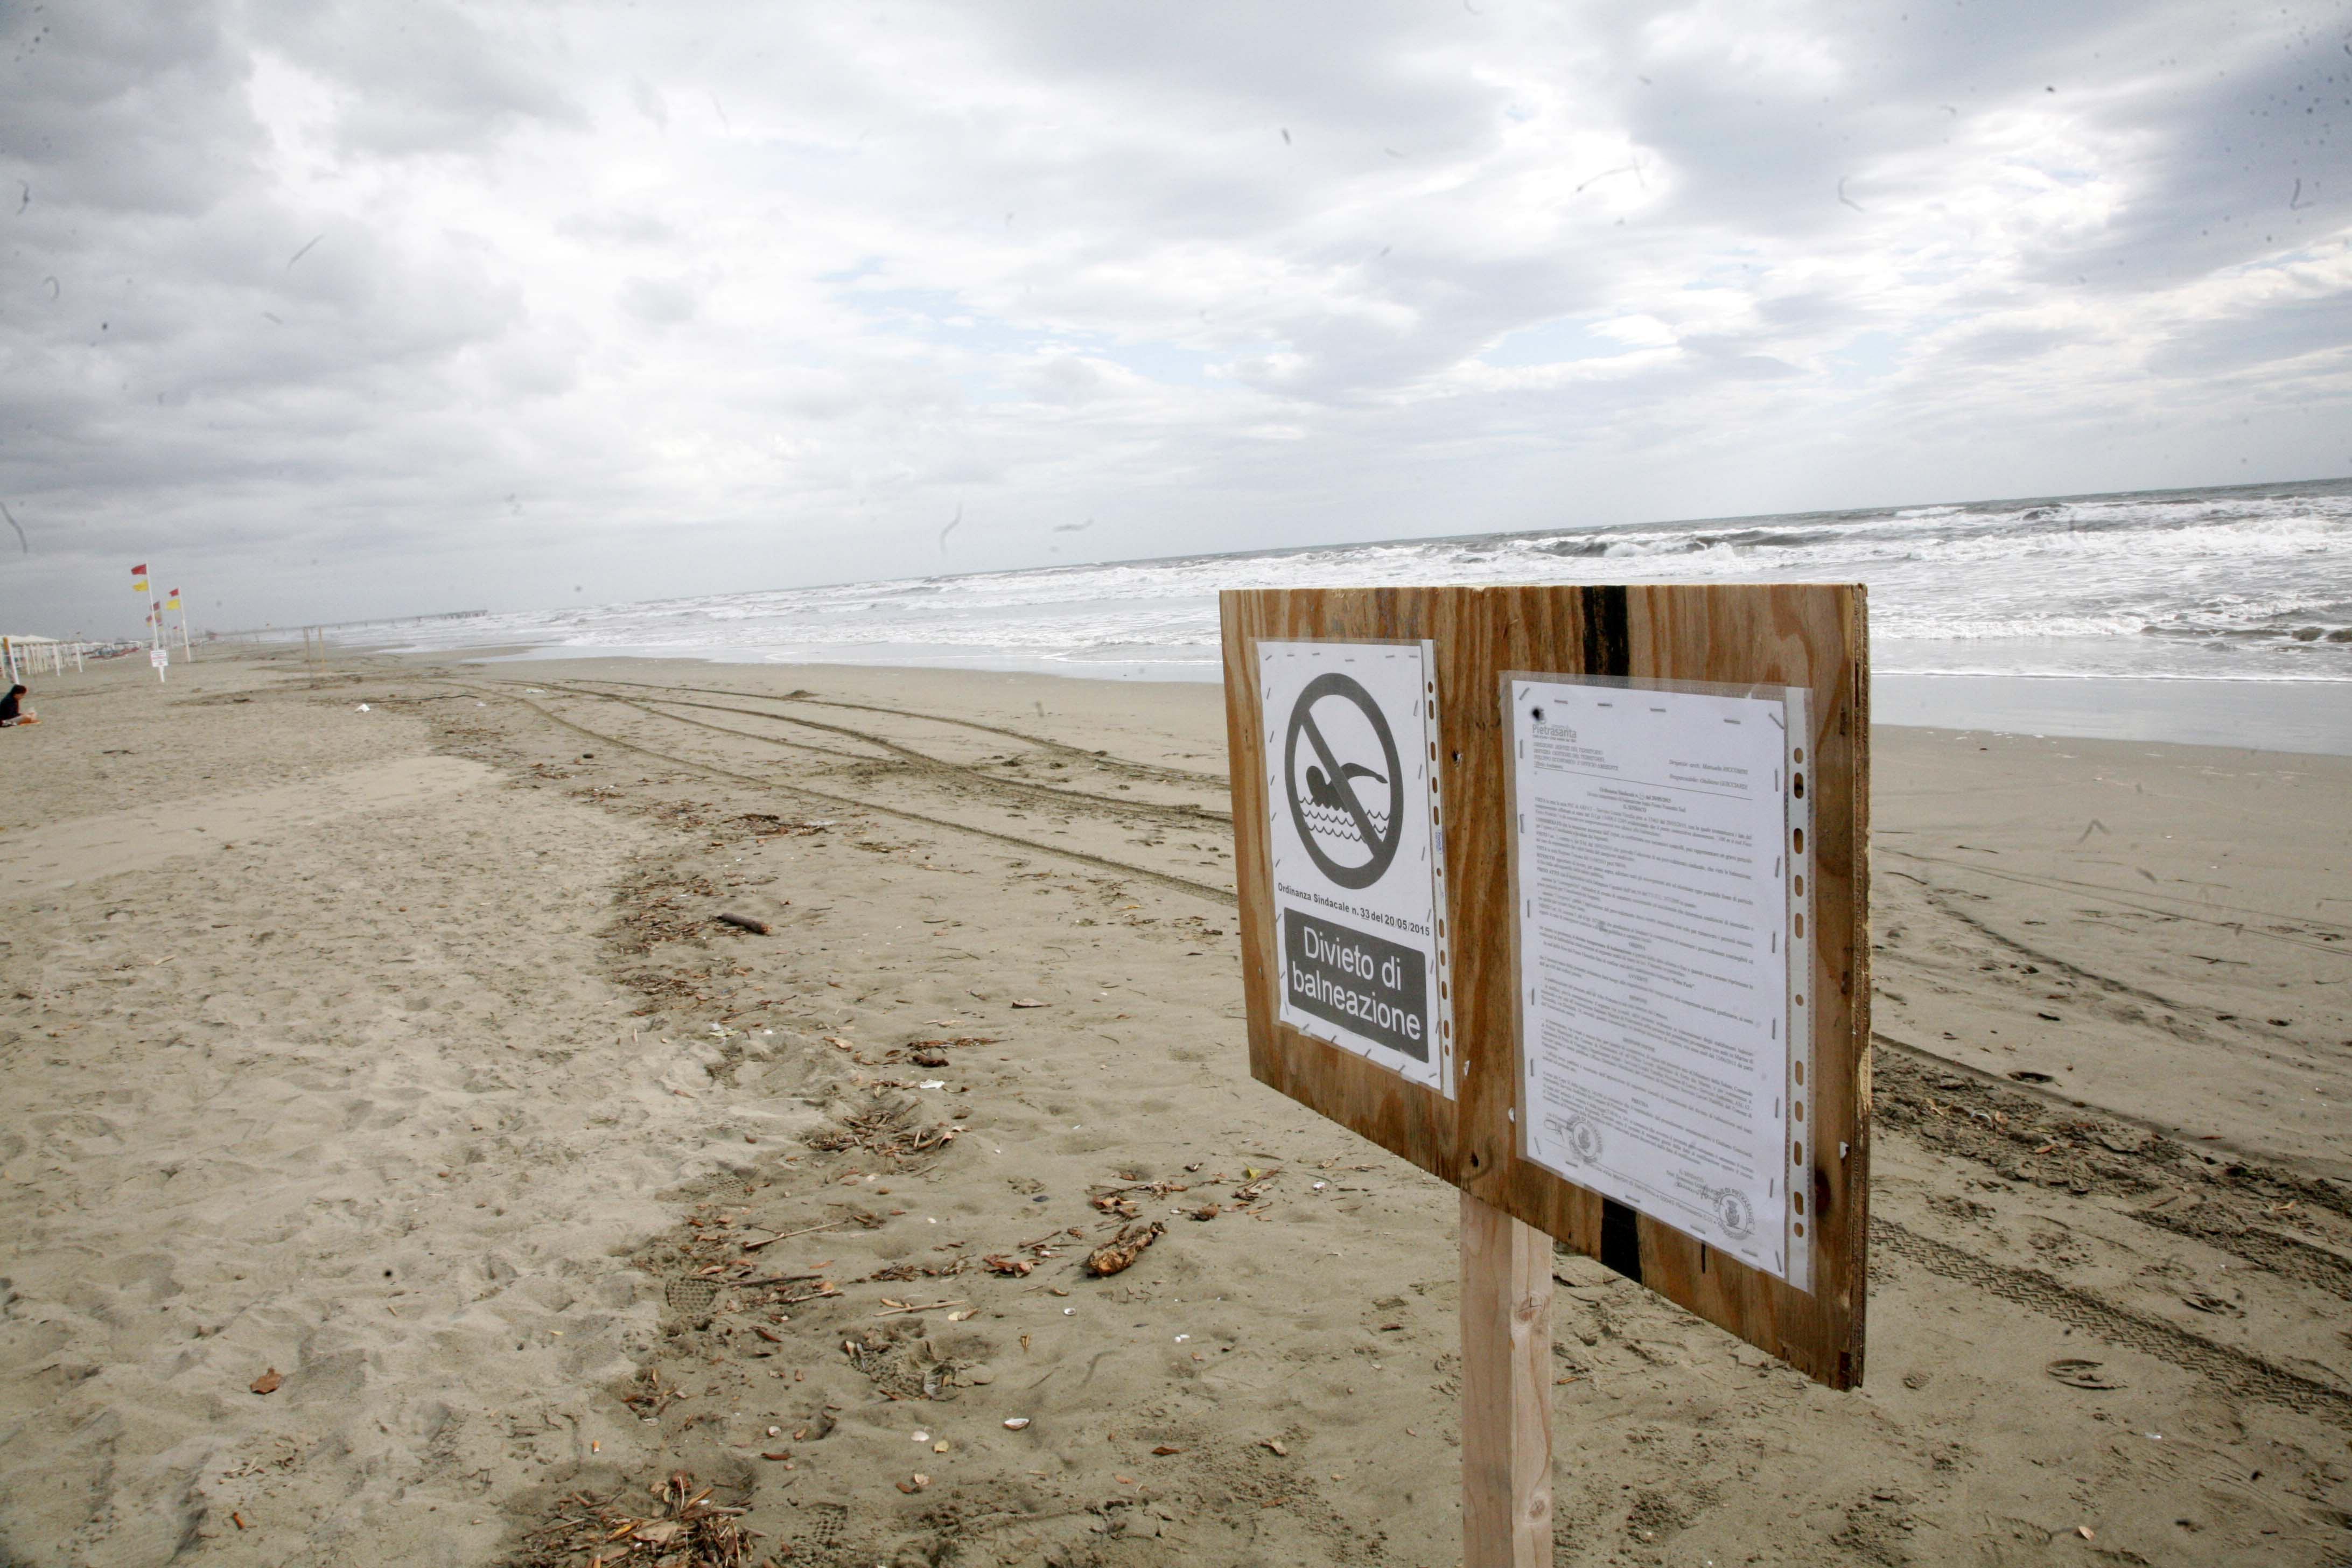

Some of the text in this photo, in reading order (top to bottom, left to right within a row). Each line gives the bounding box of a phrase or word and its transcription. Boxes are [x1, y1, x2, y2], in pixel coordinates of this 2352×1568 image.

[1532, 724, 1577, 738] Pietrasanta
[1278, 883, 1430, 936] Ordinanza Sindacale n. 33 del 20/05/2015
[1304, 926, 1402, 991] Divieto di
[1292, 961, 1421, 1040] balneazione
